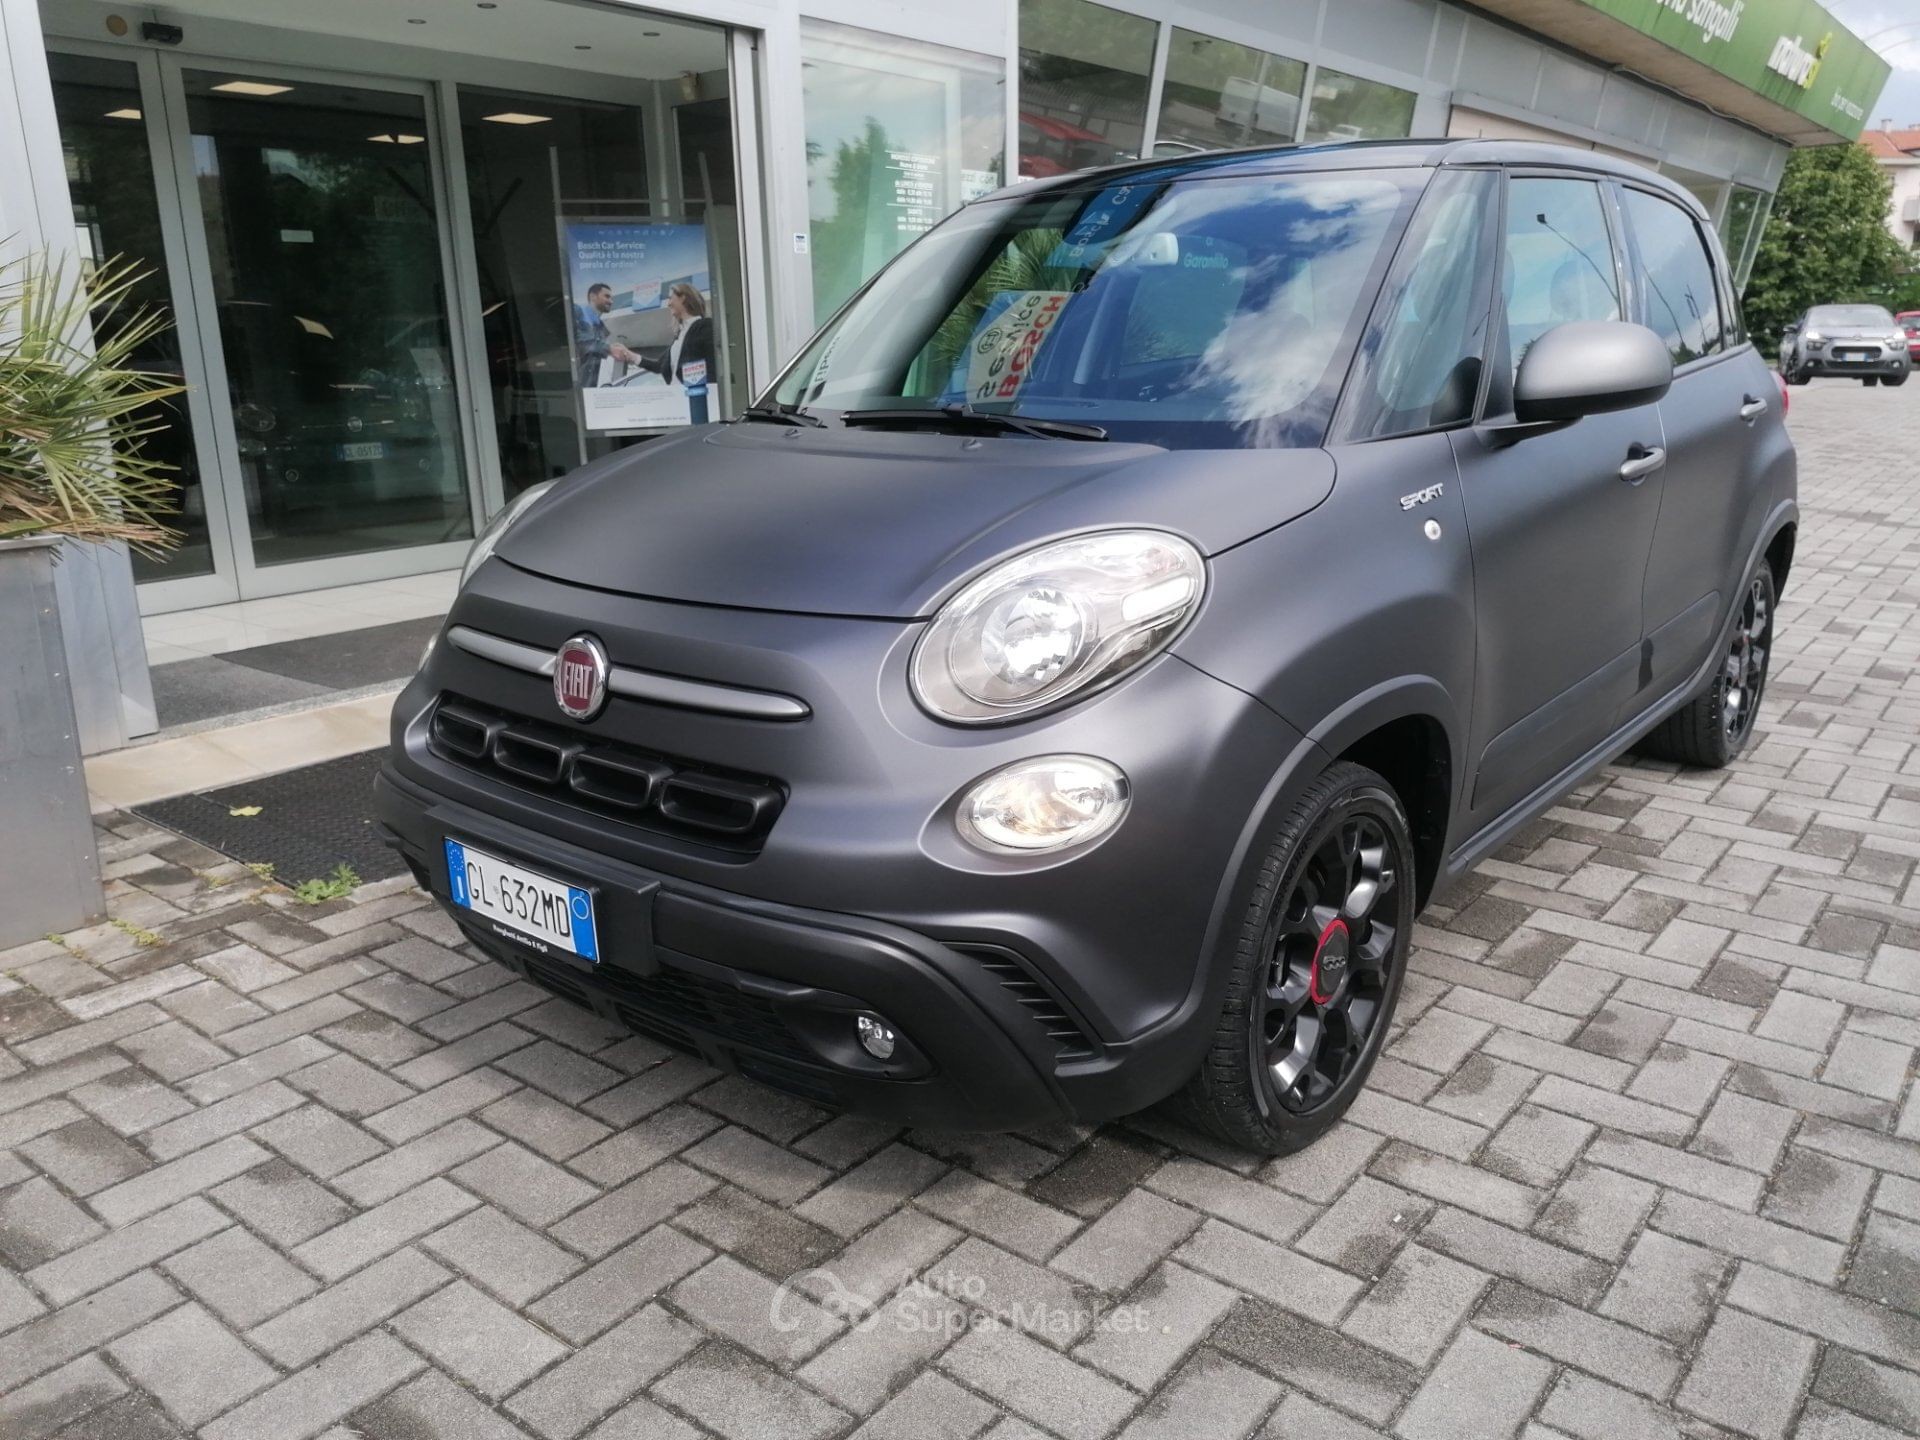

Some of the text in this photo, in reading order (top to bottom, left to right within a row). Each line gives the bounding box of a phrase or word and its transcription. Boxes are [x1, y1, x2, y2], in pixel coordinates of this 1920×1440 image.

[1686, 0, 1744, 43] sangalli
[577, 241, 600, 250] Bosch
[601, 241, 614, 250] Car
[1400, 482, 1443, 511] SPORT
[562, 660, 593, 700] FIAT
[467, 861, 493, 907] GL
[500, 875, 571, 938] 632MD
[1323, 955, 1346, 971] 500
